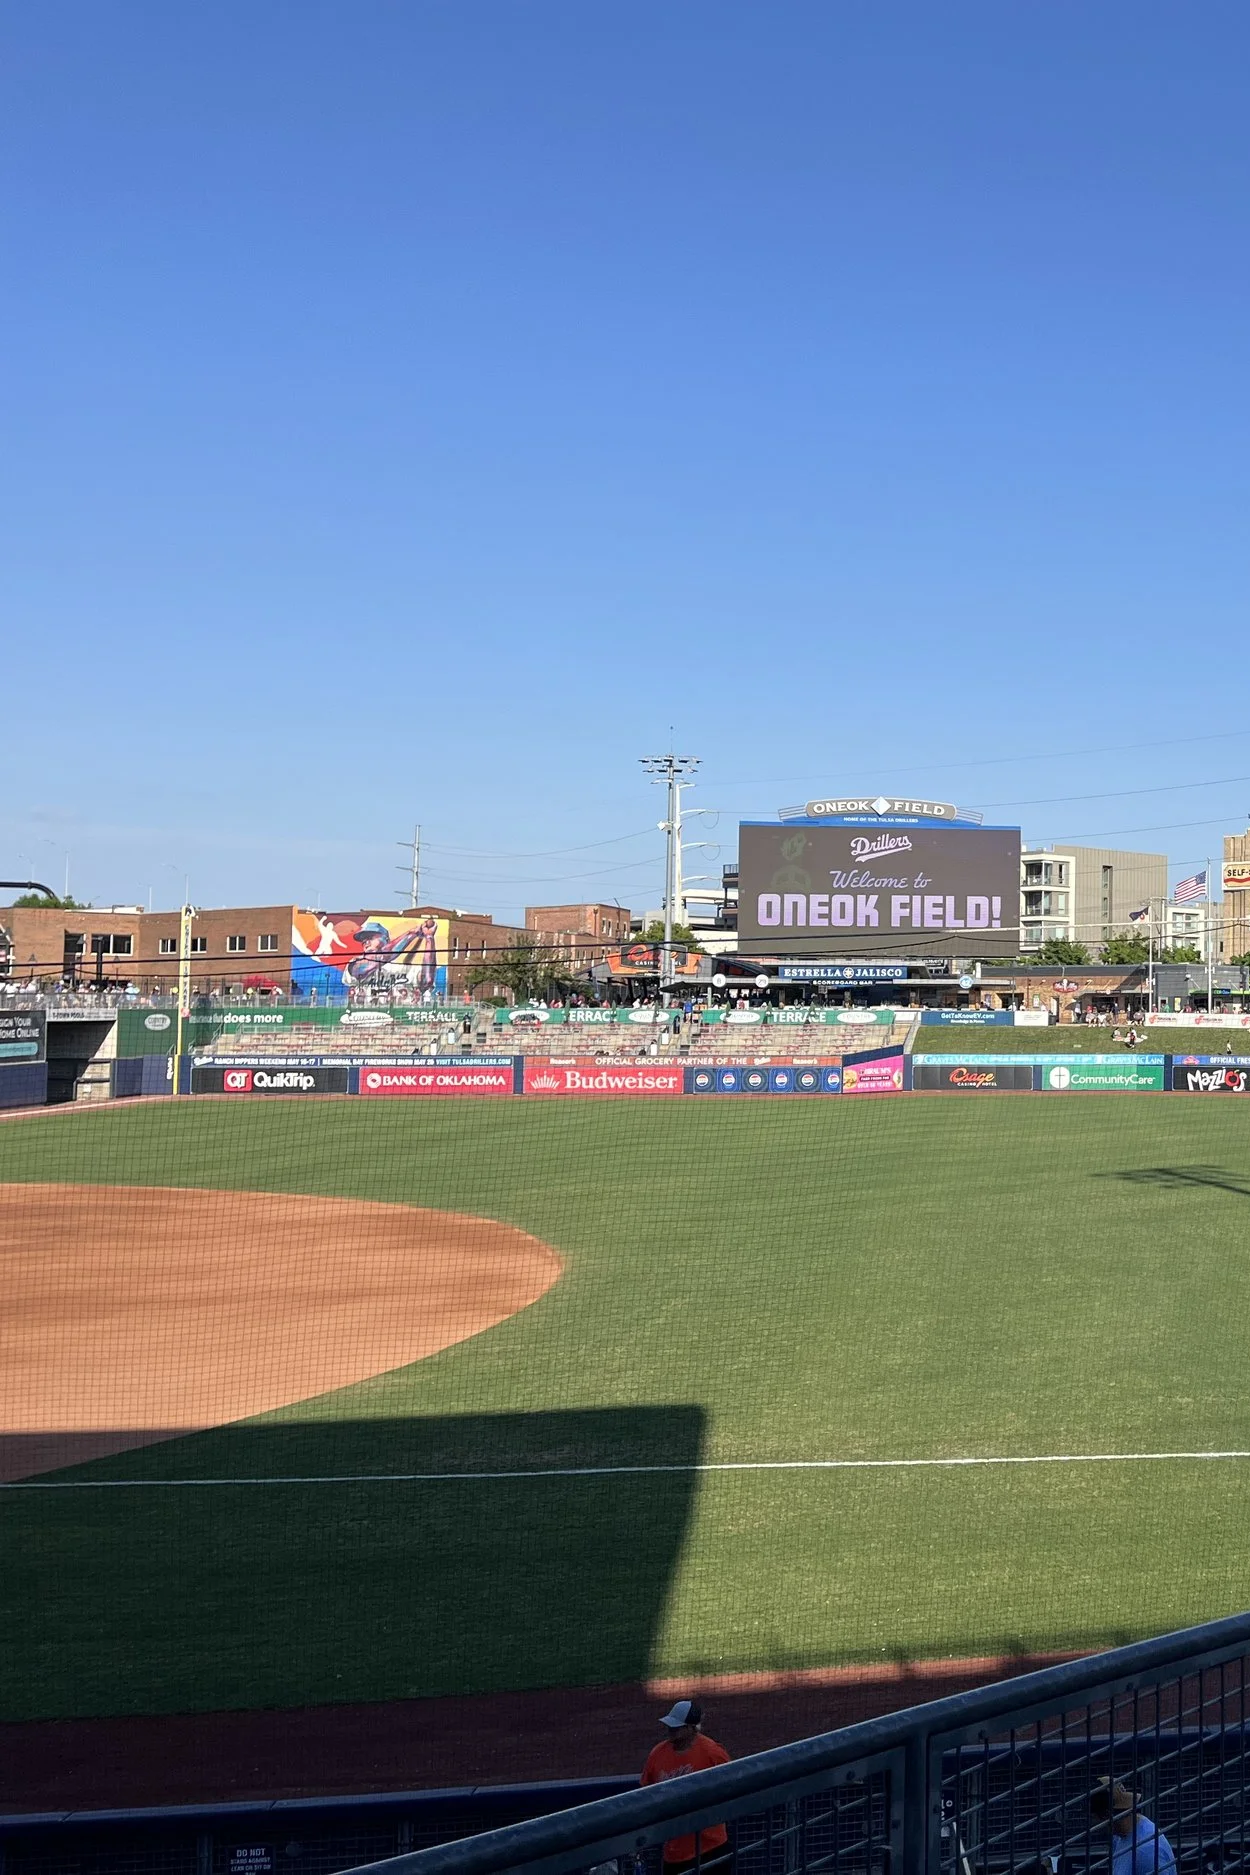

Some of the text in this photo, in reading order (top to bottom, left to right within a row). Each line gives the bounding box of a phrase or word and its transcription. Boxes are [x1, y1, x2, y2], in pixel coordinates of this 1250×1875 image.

[813, 800, 945, 816] ONEOK FIELD
[850, 833, 912, 862] Drillers
[830, 870, 932, 889] Welcome to
[757, 893, 1002, 928] ONEOK FIELD!
[784, 968, 902, 977] ESTRELLA JALISCO
[14, 1016, 31, 1027] YOUR
[224, 1012, 251, 1023] does
[254, 1014, 283, 1023] more
[771, 1011, 826, 1022] TERRACE
[16, 1027, 40, 1038] ONLINE
[595, 1057, 633, 1065] OFFICIAL
[635, 1057, 674, 1065] GROCERY
[677, 1057, 713, 1065] PARTNER
[716, 1057, 728, 1065] OF
[731, 1057, 747, 1065] THE
[1210, 1057, 1235, 1065] OFFICIAL
[227, 1072, 314, 1090] QT QuikTrip
[383, 1075, 506, 1086] BANK OF OKLAHOMA
[564, 1071, 677, 1089] Budweiser
[949, 1067, 995, 1087] Osage
[1071, 1074, 1154, 1086] CommunityCare
[236, 1848, 266, 1857] DO NOT
